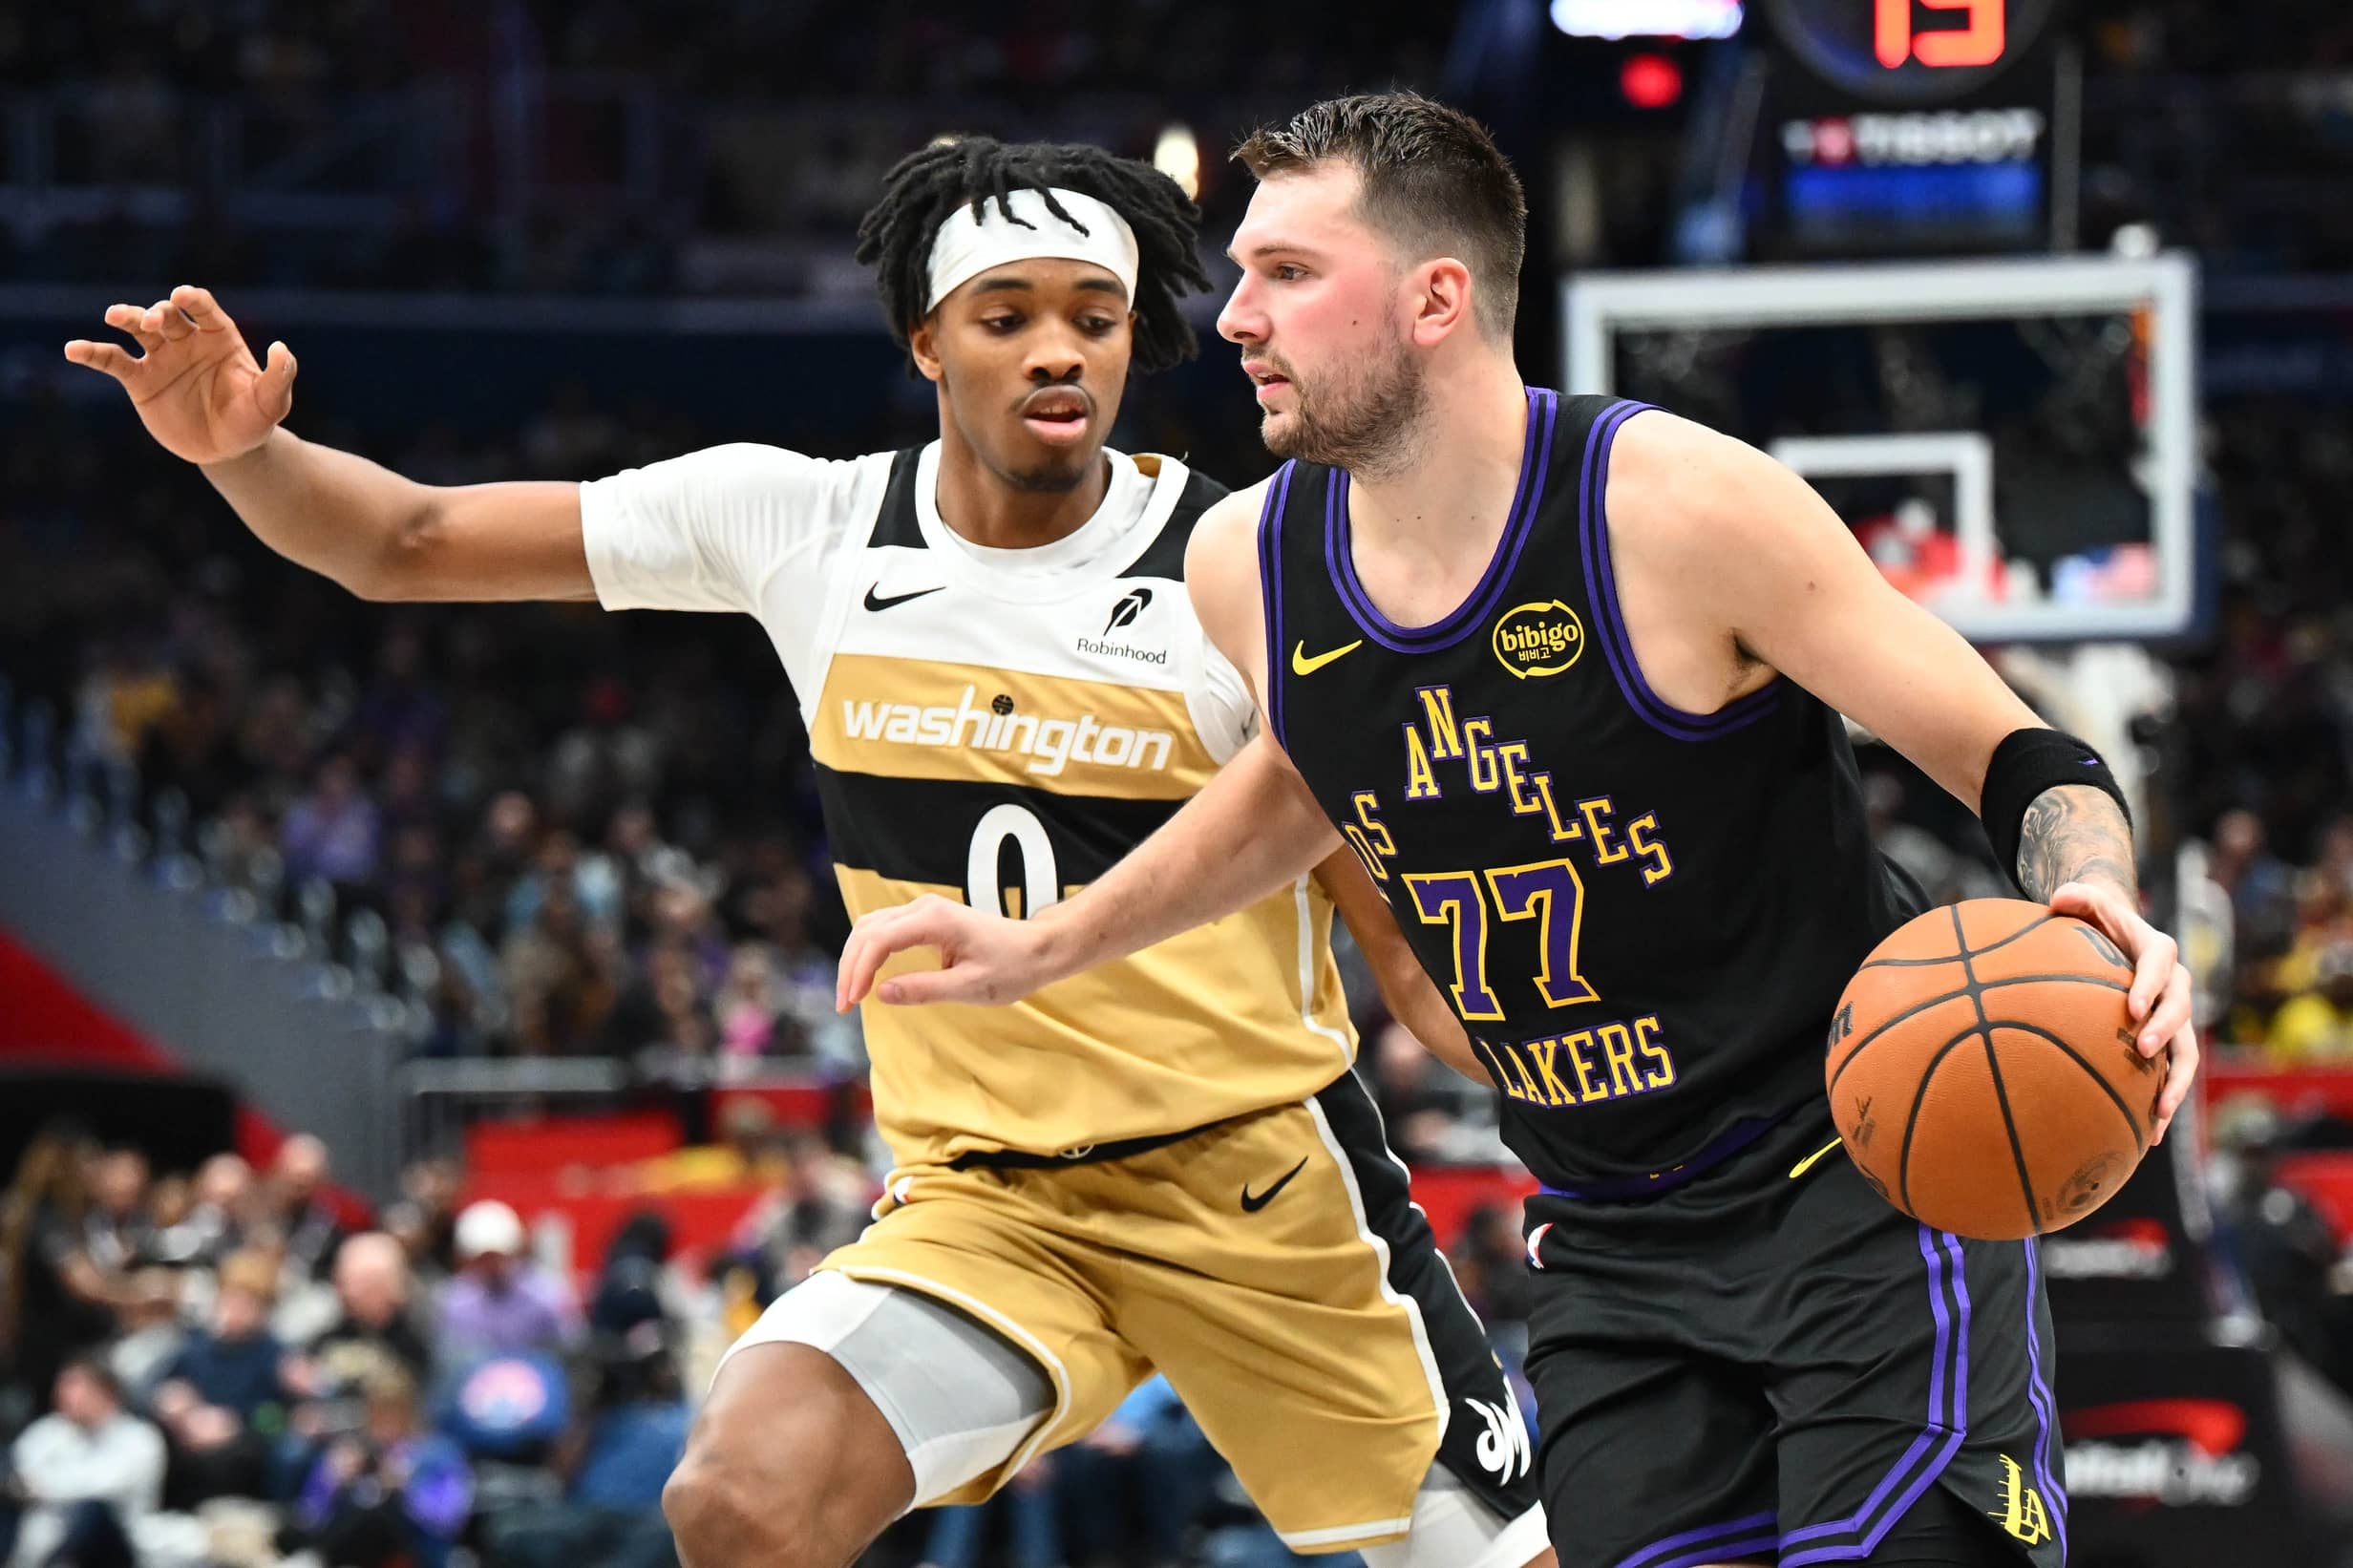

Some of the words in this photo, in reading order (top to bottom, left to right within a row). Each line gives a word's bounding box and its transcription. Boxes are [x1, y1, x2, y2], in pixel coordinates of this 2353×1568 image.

[1076, 637, 1167, 665] Robinhood
[1500, 622, 1579, 652] bibigo
[1517, 647, 1552, 663] 비비고
[842, 684, 1174, 777] washington
[1341, 789, 1398, 901] OS
[1402, 684, 1674, 888] ANGELES
[1401, 858, 1601, 1021] 77
[1476, 1012, 1677, 1109] LAKERS
